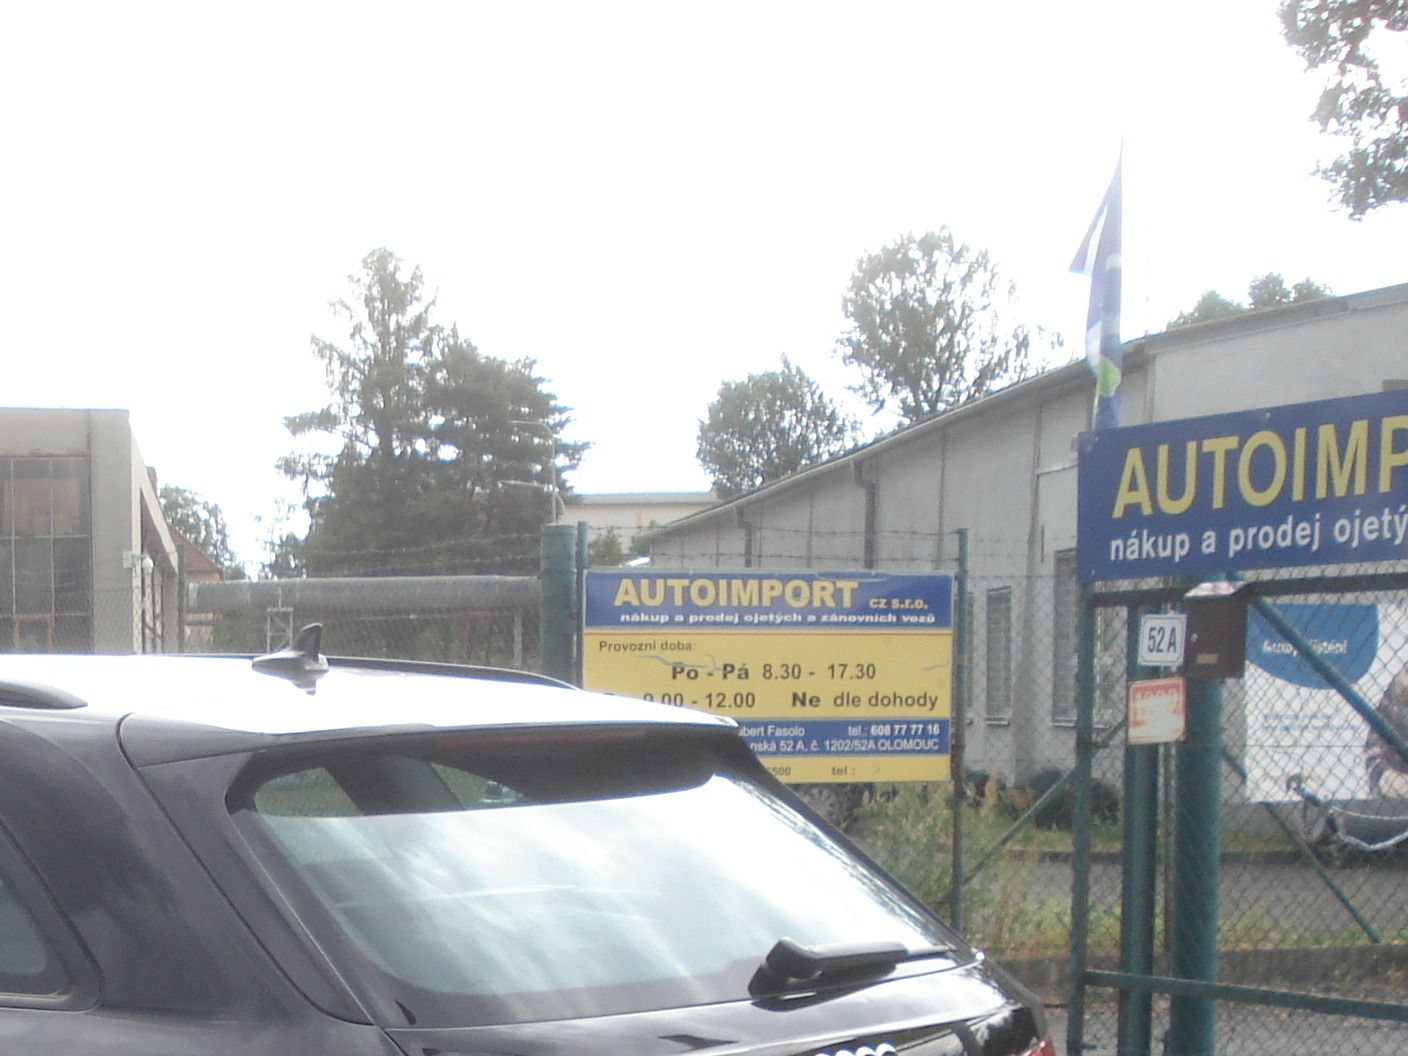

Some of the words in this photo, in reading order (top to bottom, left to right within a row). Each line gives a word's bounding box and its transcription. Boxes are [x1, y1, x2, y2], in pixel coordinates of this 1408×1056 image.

[1110, 528, 1190, 562] nákup
[1201, 530, 1216, 554] a
[1229, 513, 1321, 558] prodej
[613, 578, 859, 609] AUTOIMPORT
[869, 598, 888, 608] cz
[891, 598, 928, 609] s.r.o.
[620, 612, 670, 624] nákup
[674, 614, 684, 622] a
[689, 612, 739, 624] prodej
[744, 612, 802, 624] ojetých
[807, 614, 816, 622] a
[821, 612, 897, 623] zánovních
[902, 613, 935, 623] vozů
[599, 640, 656, 652] Provozní
[660, 640, 696, 651] doba:
[671, 663, 699, 680] Po
[722, 663, 749, 680] Pá
[762, 663, 802, 680] 8.30
[827, 663, 876, 680] 17.30
[705, 692, 756, 708] 12.00
[792, 691, 821, 707] Ne
[833, 691, 861, 707] dle
[868, 691, 938, 711] dohody
[768, 725, 805, 737] Fasolo
[870, 725, 891, 736] 608
[894, 725, 908, 735] 77
[911, 725, 924, 735] 77
[927, 724, 940, 735] 16
[779, 741, 793, 751] 52
[825, 740, 876, 751] 1202/52A
[880, 739, 939, 750] OLOMOUC
